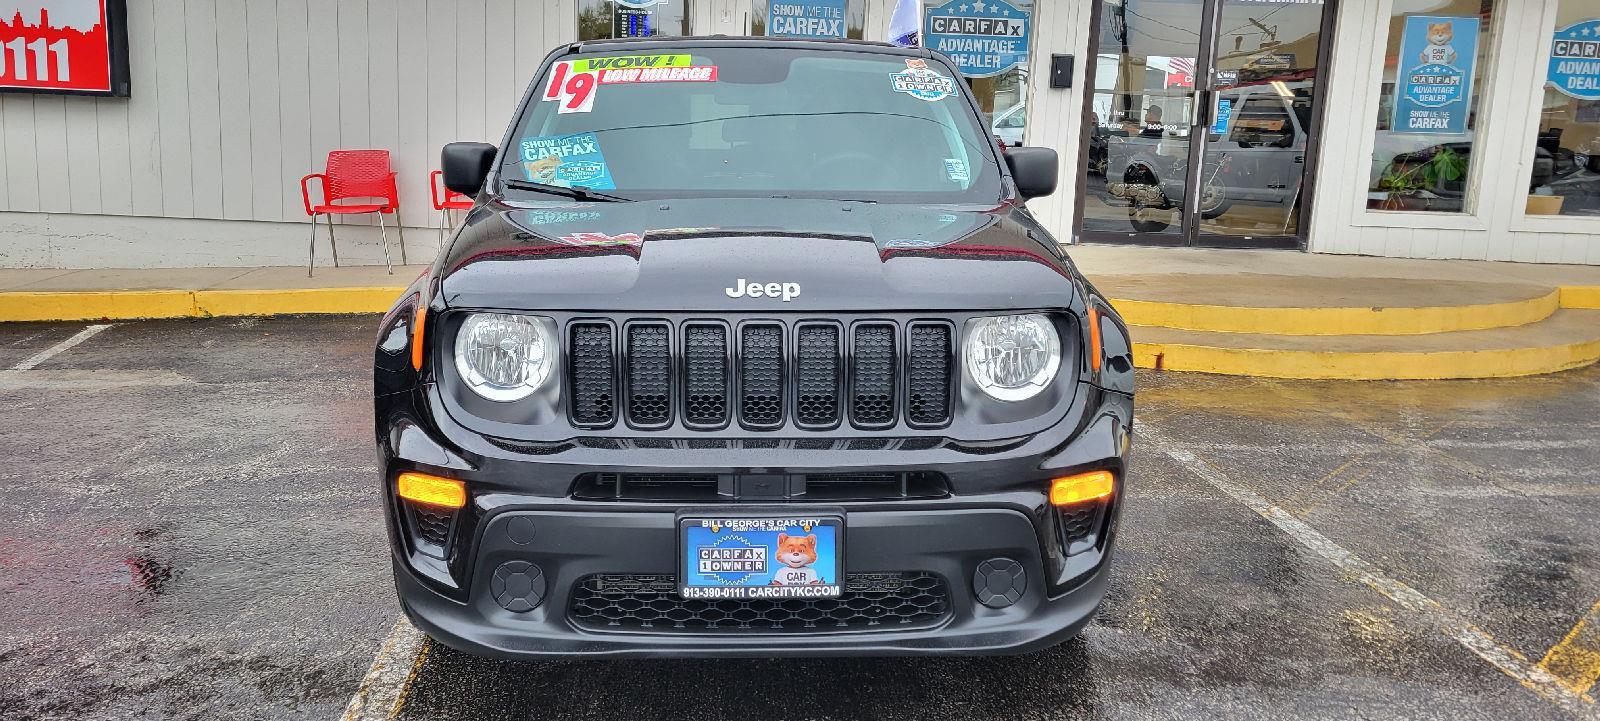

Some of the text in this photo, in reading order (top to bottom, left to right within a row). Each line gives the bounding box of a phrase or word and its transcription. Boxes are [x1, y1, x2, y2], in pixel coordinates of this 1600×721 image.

[773, 4, 841, 18] SHOW ME THE
[773, 16, 840, 36] CARFAX
[934, 19, 1021, 36] CARFAX
[938, 38, 1015, 53] ADVANTAGE
[0, 36, 70, 81] 111
[951, 53, 1000, 68] DEALER
[603, 67, 712, 82] LOW MILEAGE
[1411, 75, 1460, 86] CARFAX
[1413, 86, 1455, 94] ADVANTAGE
[1419, 94, 1447, 102] DEALER
[1410, 110, 1429, 118] SHOW
[1409, 118, 1450, 129] CARFAX
[522, 135, 593, 150] SHOW ME THE
[524, 142, 598, 160] CARFAX
[725, 279, 801, 302] Jeep
[702, 520, 723, 528] BILL
[724, 520, 774, 528] GEORGE'S
[776, 519, 797, 527] CAR
[701, 550, 764, 560] CARFAX
[786, 572, 806, 581] CAR
[683, 586, 840, 598] 913-390-0111 CARCITYKC.COM
